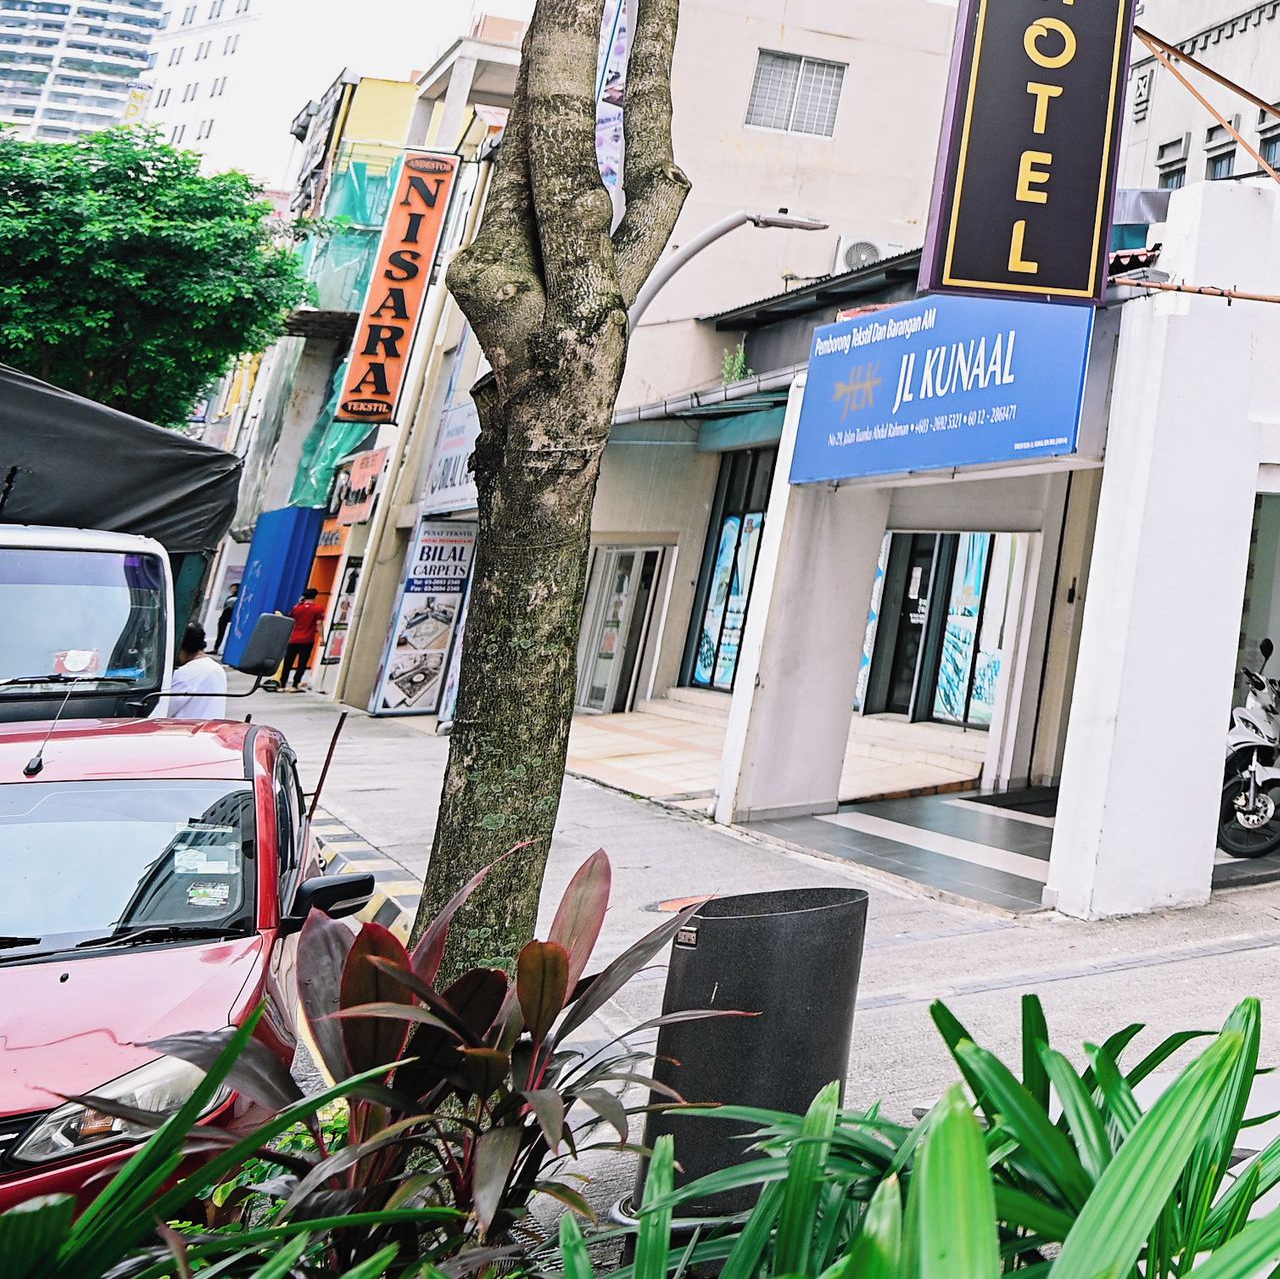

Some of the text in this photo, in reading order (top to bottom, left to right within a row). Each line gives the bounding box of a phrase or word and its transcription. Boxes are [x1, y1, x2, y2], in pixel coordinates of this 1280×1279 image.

[350, 176, 444, 396] NISARA
[814, 307, 937, 357] Pemborong Tekstil Dan Barangan AM
[892, 330, 1016, 415] JL KUNAAL
[347, 402, 389, 413] TEKSTIL
[419, 545, 467, 562] BILAL
[413, 565, 466, 576] CARPETS
